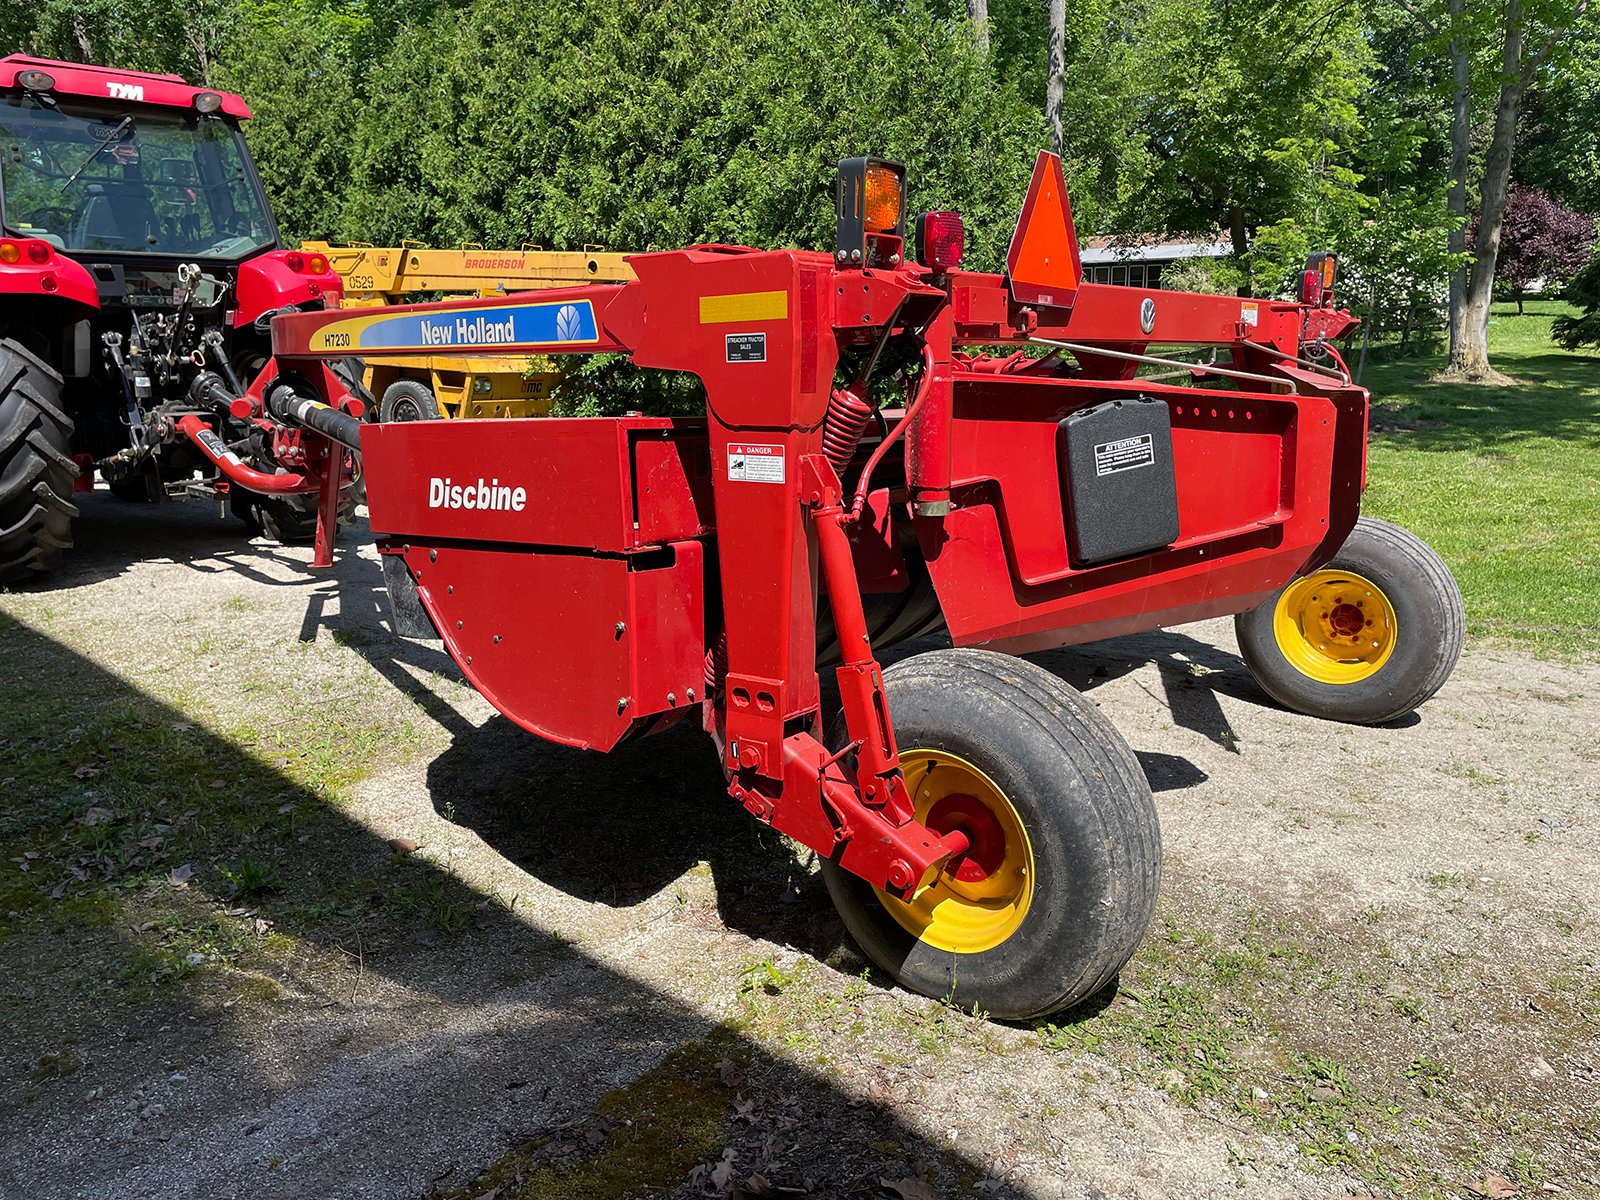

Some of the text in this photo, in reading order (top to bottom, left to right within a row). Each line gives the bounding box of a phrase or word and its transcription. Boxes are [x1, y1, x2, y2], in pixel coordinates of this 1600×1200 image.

[106, 81, 144, 101] TYM
[465, 258, 525, 270] BRODERSON
[349, 275, 374, 289] 0529
[420, 315, 515, 345] New Holland
[324, 332, 351, 347] H7230
[746, 446, 772, 455] DANGER
[1105, 437, 1142, 452] ATTENTION
[428, 477, 527, 512] Discbine
